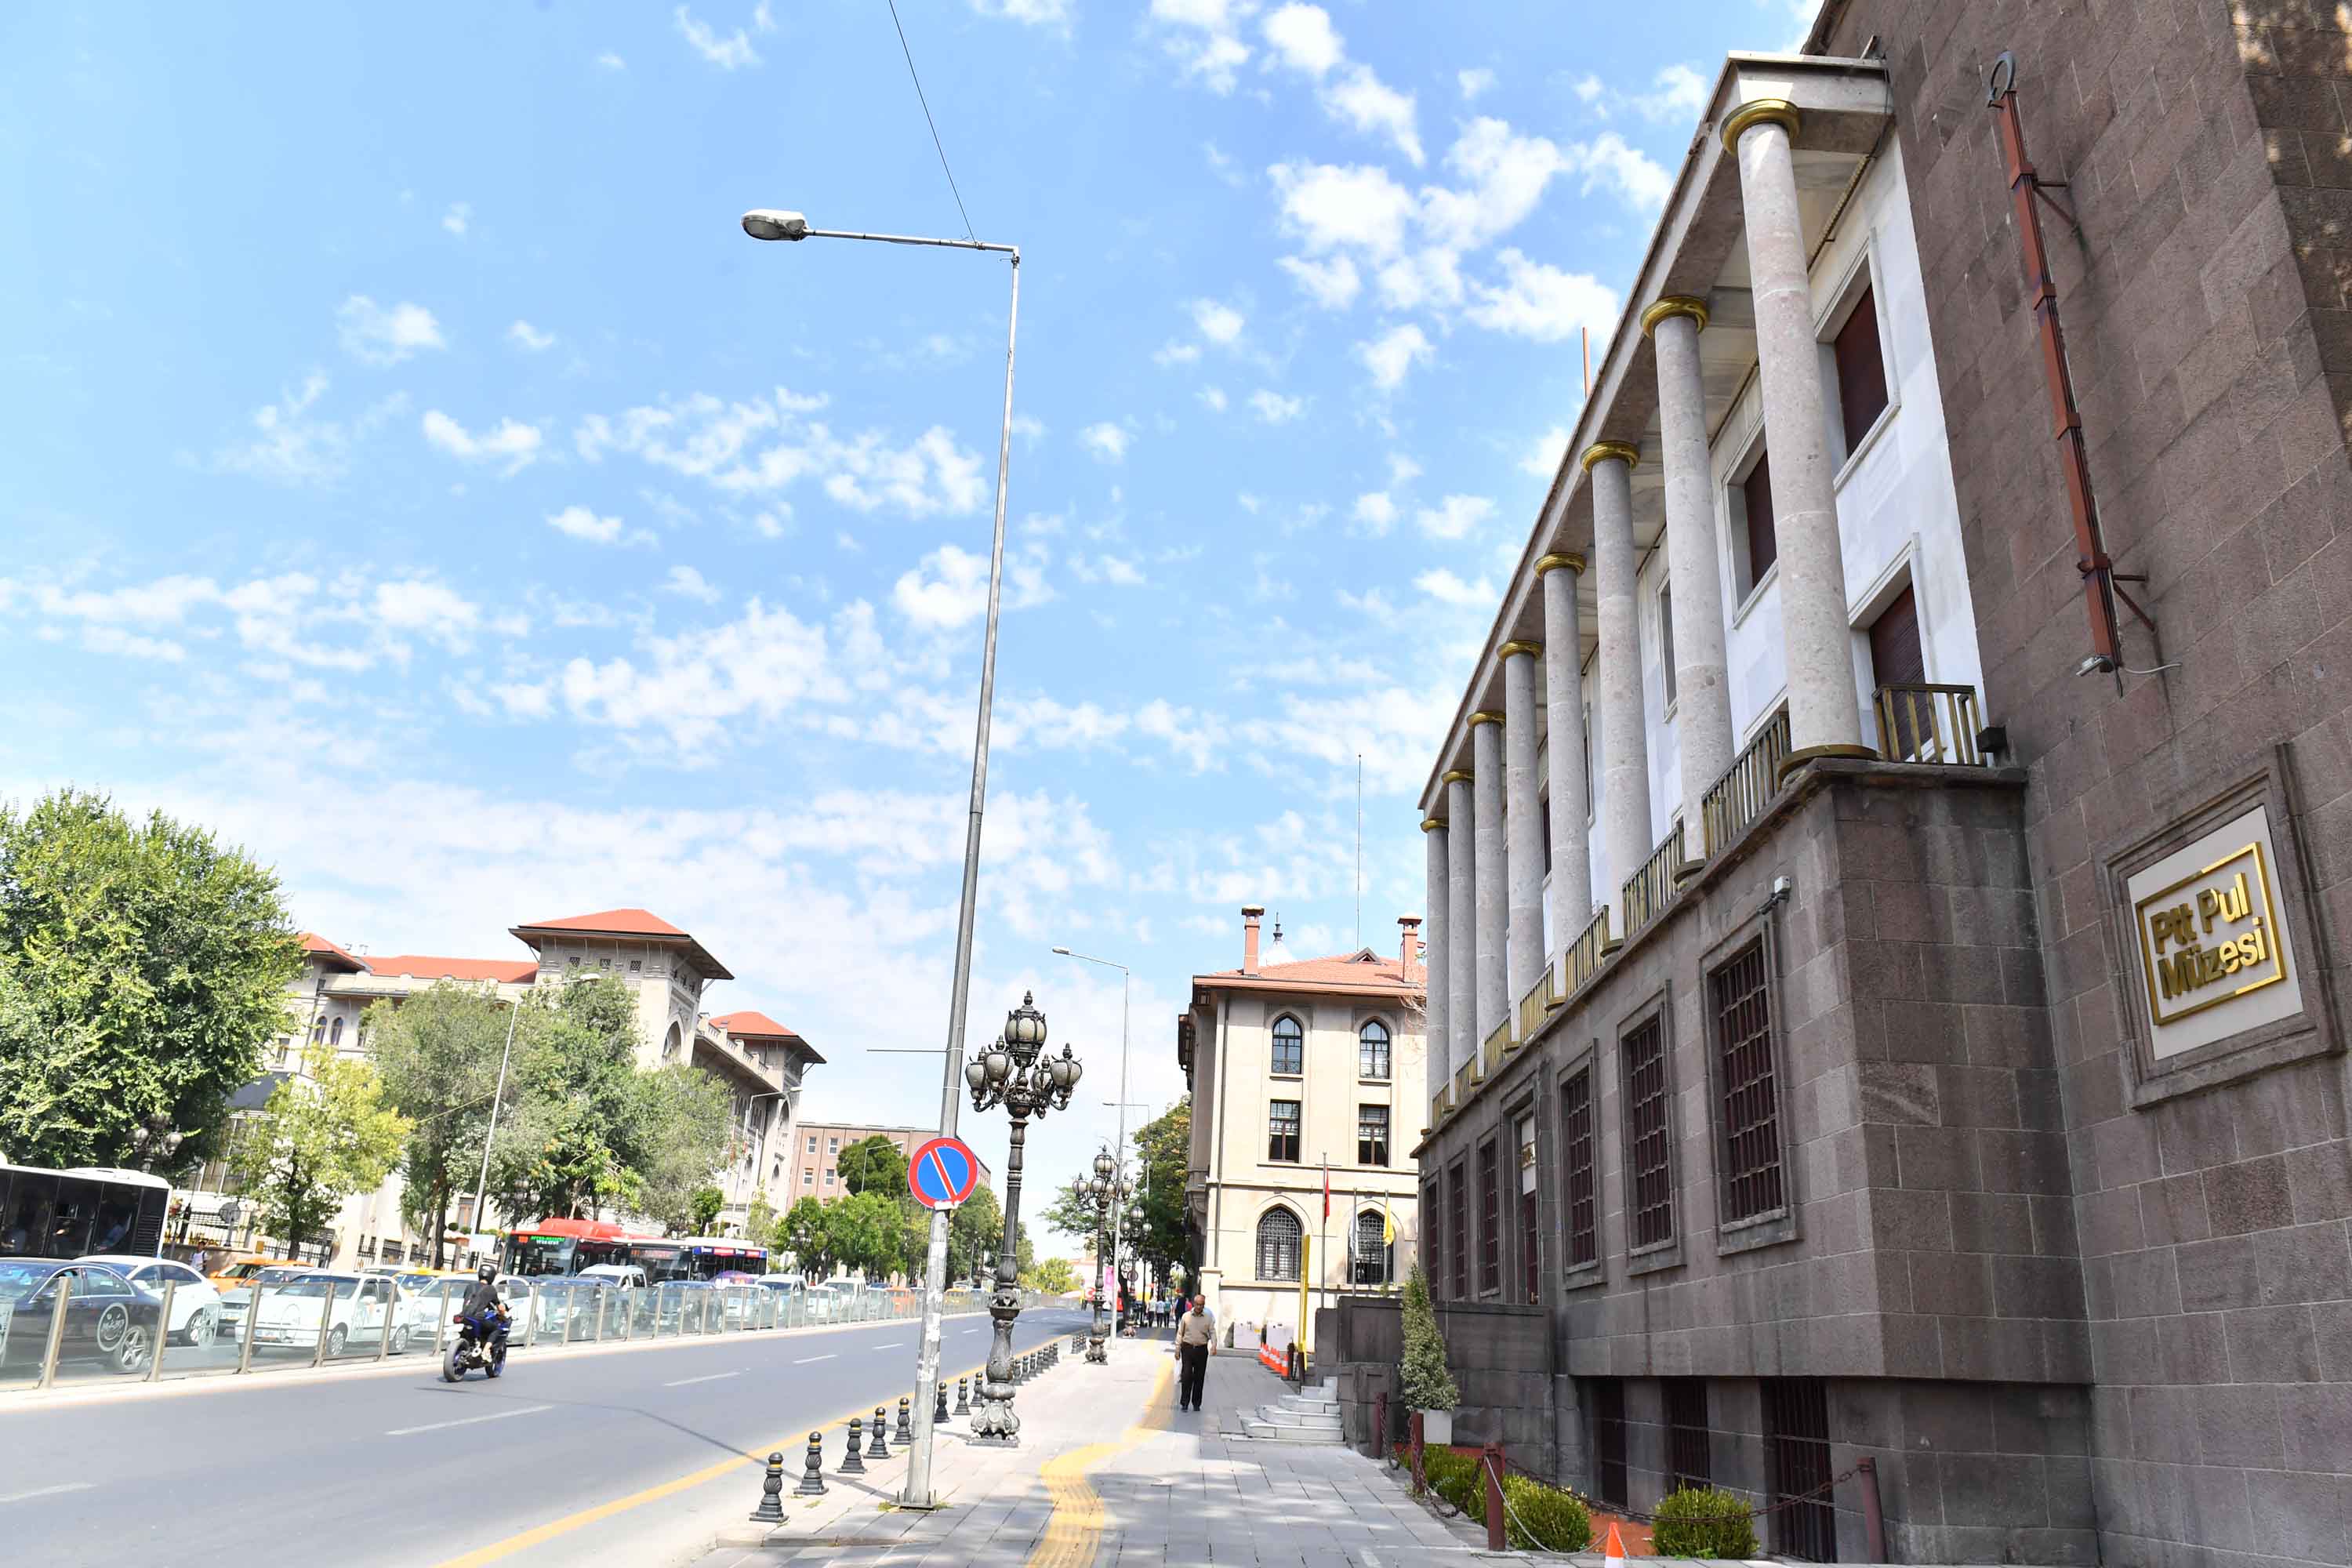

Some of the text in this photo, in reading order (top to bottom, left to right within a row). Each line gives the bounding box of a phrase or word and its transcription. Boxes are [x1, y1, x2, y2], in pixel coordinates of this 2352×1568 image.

[2151, 872, 2252, 954] Ptt Pul
[2158, 916, 2270, 1000] Müzesi
